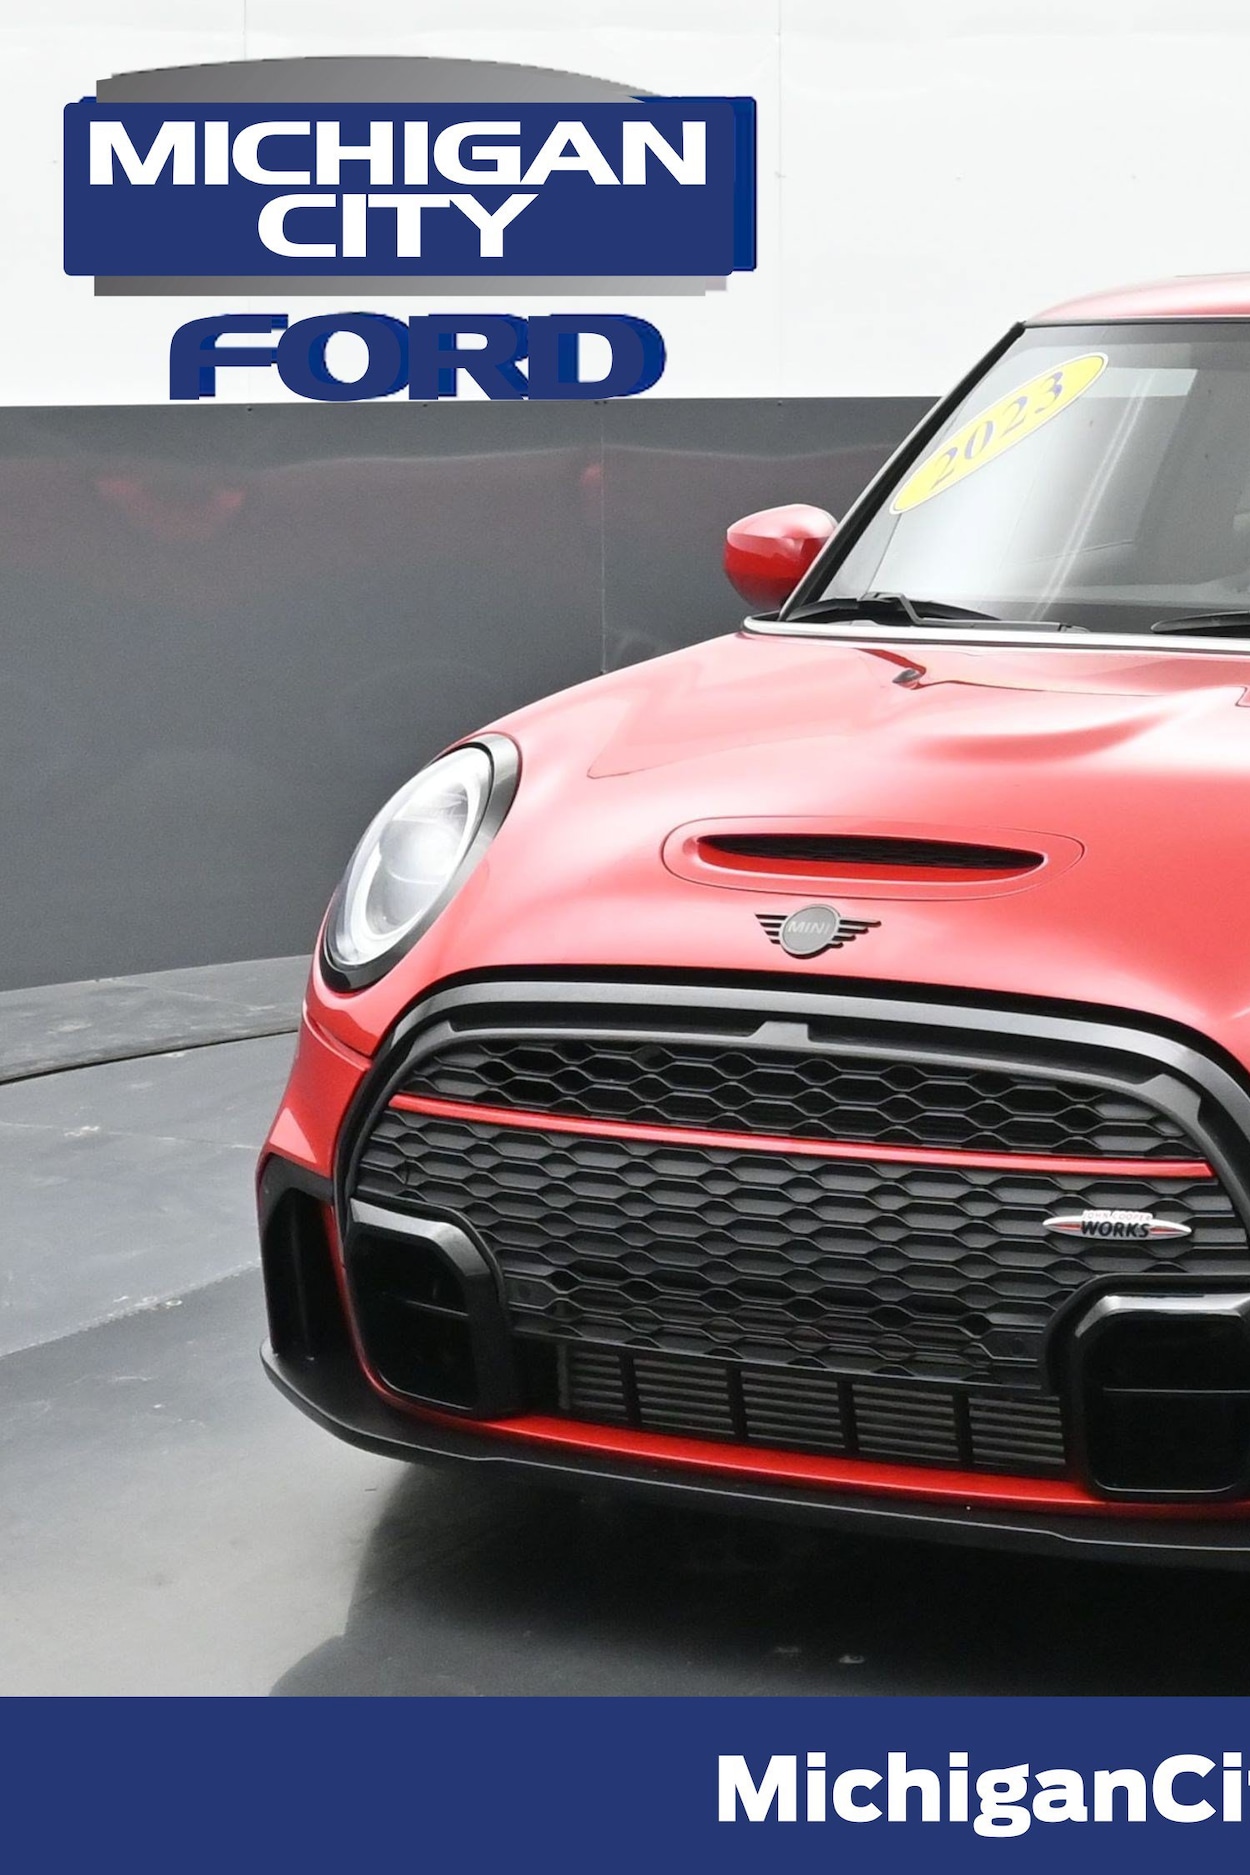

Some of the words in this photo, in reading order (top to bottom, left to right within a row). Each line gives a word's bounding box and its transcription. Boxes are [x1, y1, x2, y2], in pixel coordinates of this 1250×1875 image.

[930, 371, 1063, 491] 2023
[787, 920, 832, 935] MINI
[1081, 1221, 1151, 1238] WORKS
